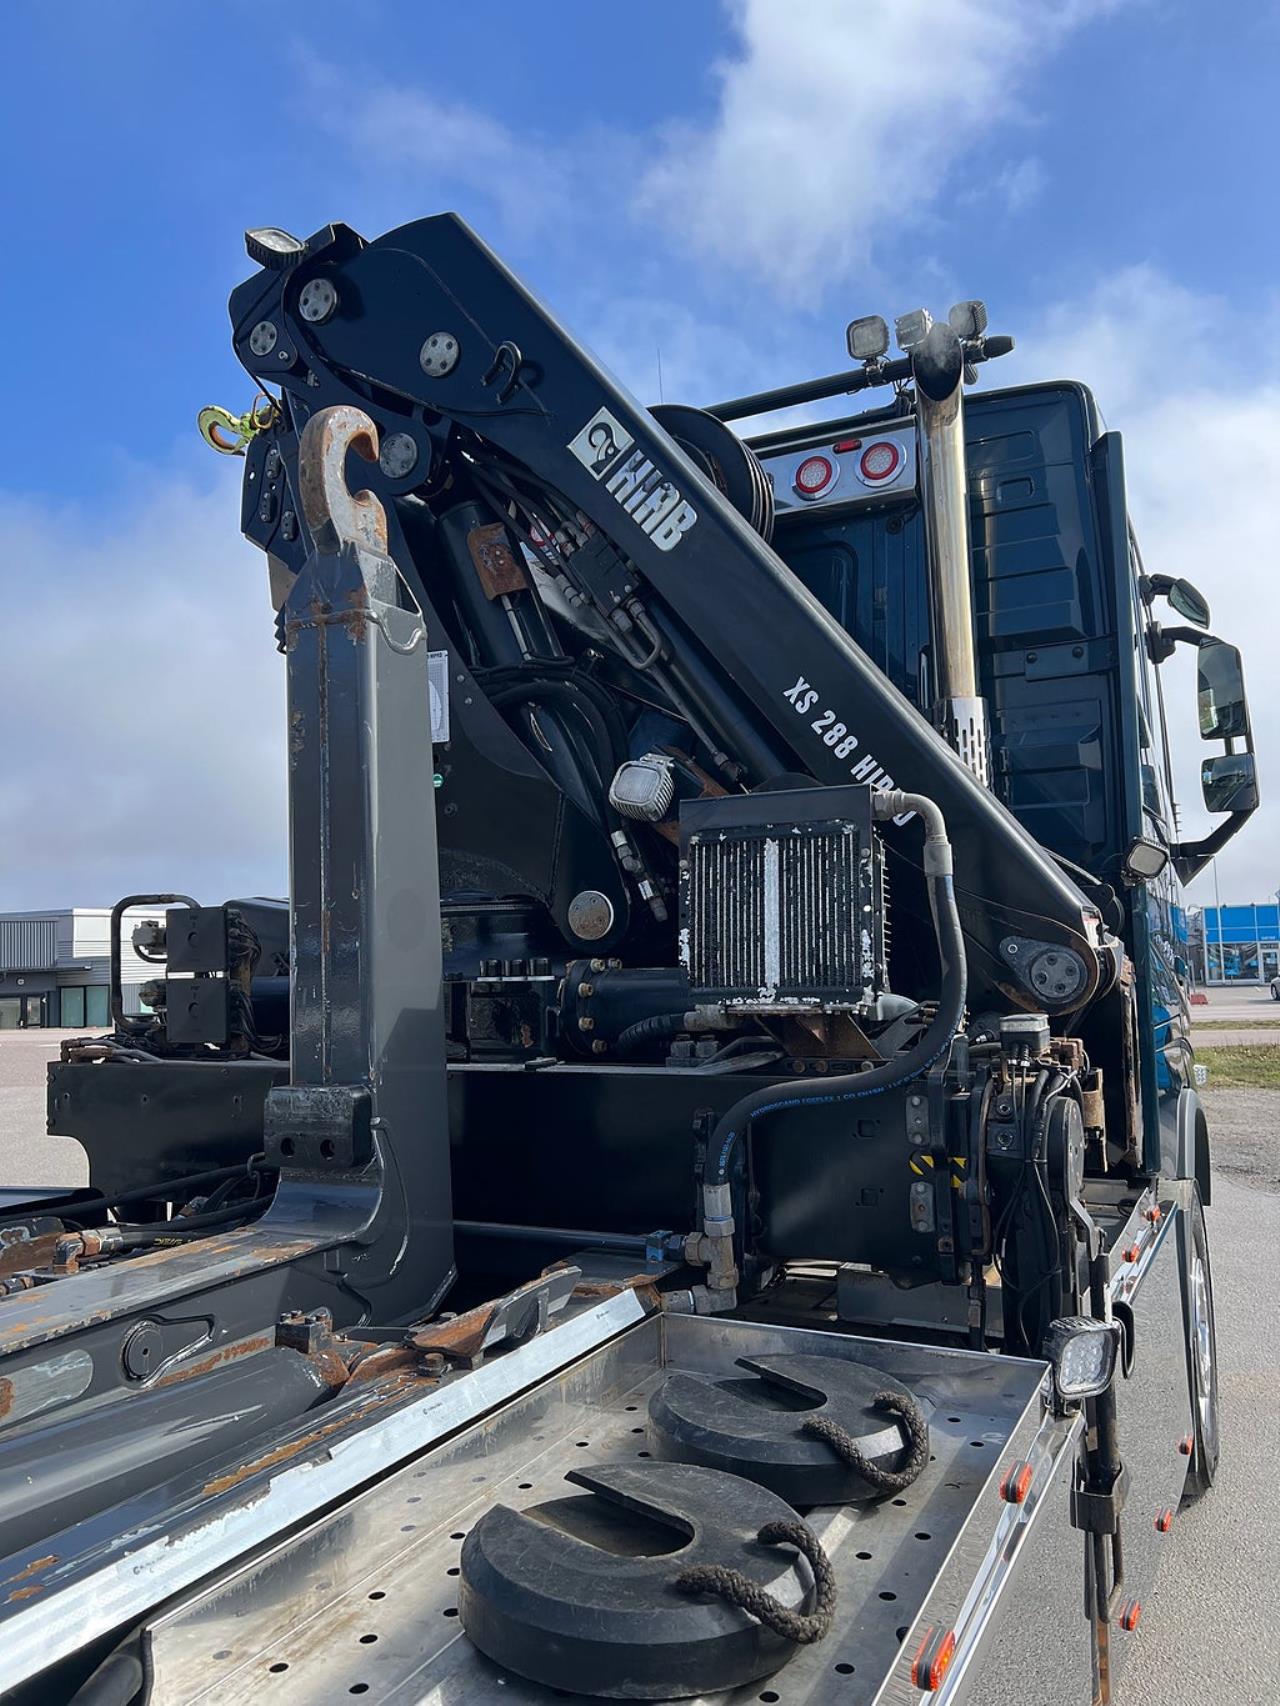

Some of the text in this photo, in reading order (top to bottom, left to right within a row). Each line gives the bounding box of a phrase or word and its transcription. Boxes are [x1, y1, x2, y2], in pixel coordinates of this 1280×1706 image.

[605, 449, 698, 552] HIAB
[782, 676, 819, 714] XS
[811, 710, 859, 760] 288
